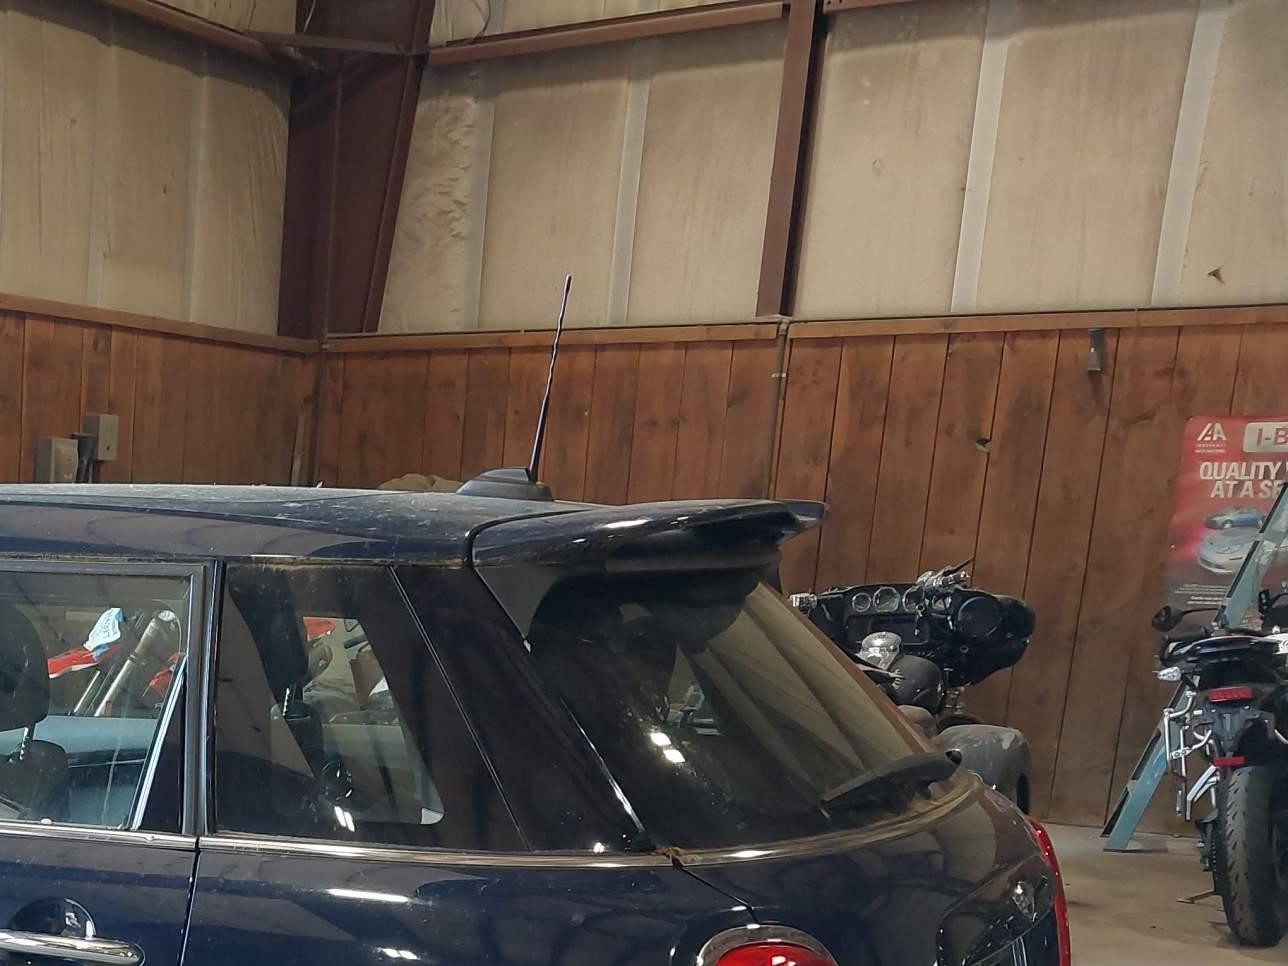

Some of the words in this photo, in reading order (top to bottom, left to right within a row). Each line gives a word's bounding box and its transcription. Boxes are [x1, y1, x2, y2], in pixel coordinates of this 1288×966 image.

[1200, 461, 1283, 480] QUALITY
[1210, 481, 1239, 499] AT
[1240, 481, 1255, 499] A
